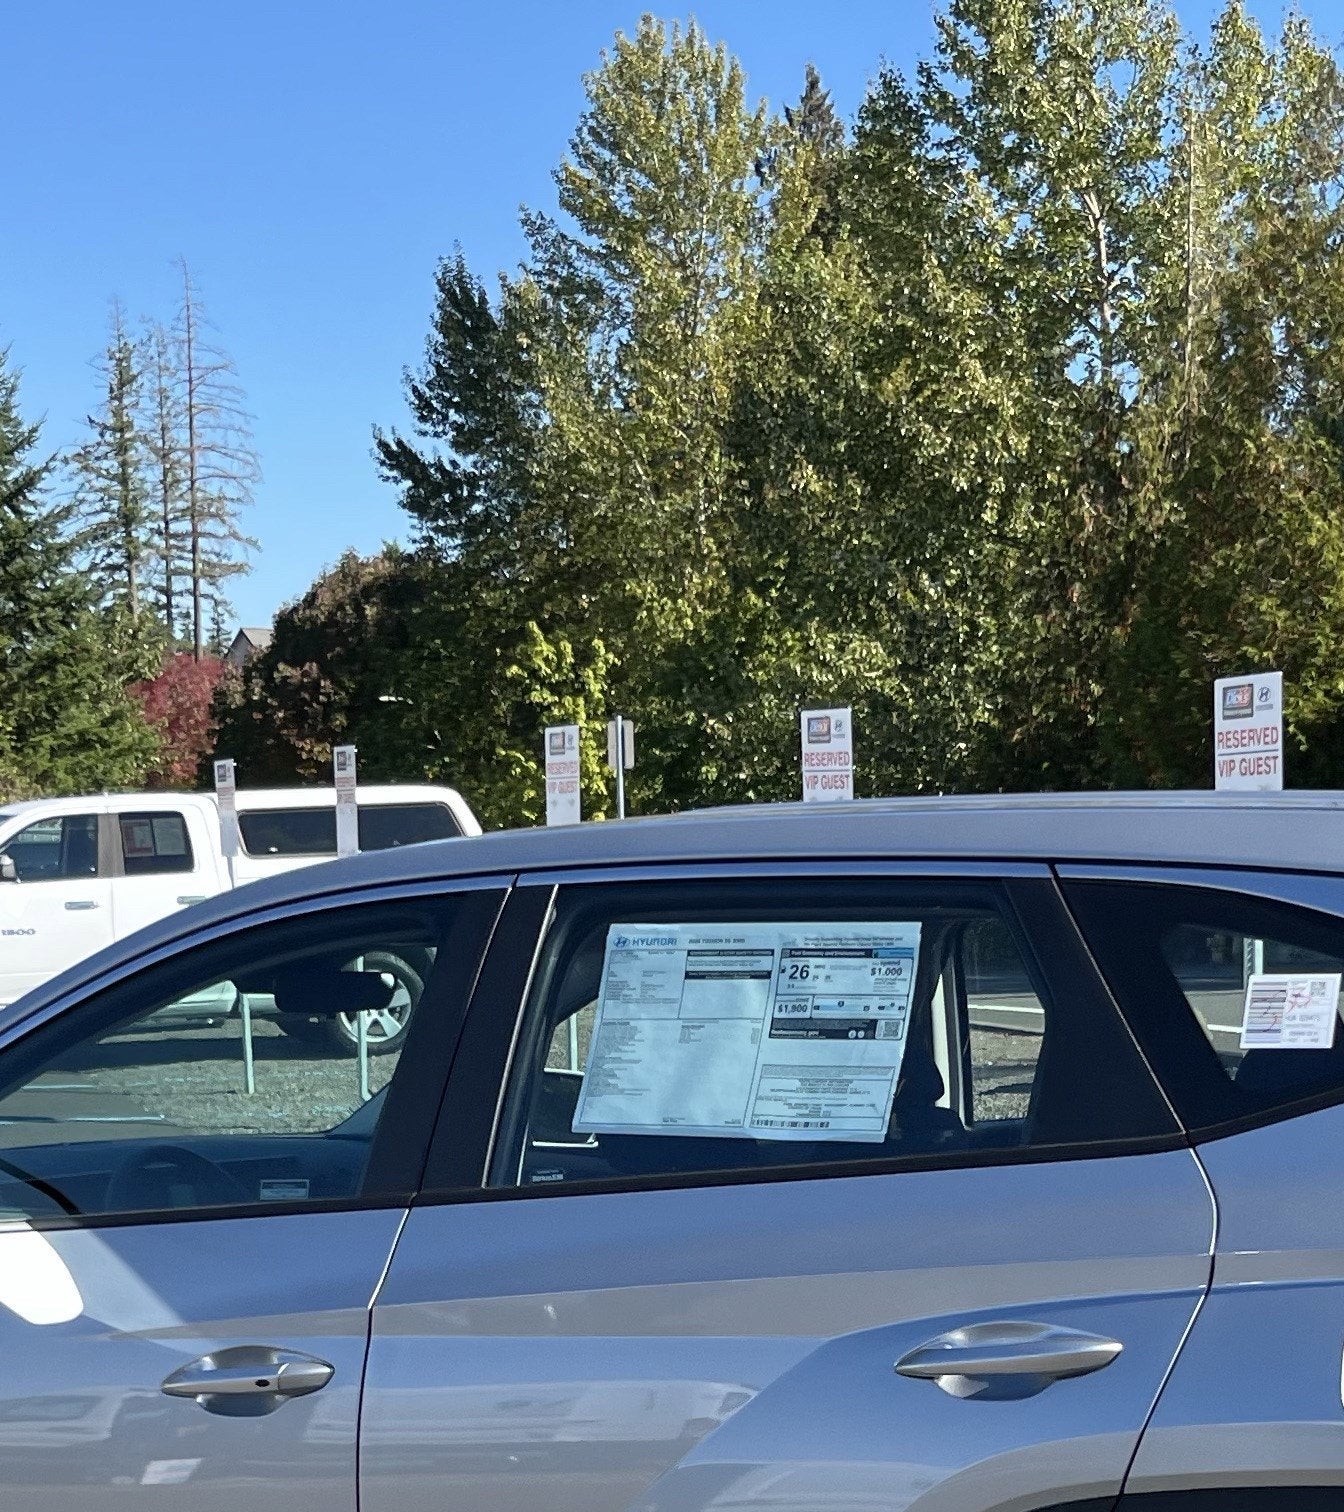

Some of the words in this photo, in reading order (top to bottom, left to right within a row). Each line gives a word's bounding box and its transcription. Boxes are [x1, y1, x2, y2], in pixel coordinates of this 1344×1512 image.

[1217, 726, 1279, 750] RESERVED
[804, 751, 851, 768] RESERVED
[1217, 758, 1236, 778] VIP
[1239, 755, 1279, 777] GUEST
[804, 775, 819, 790] VIP
[821, 773, 851, 790] GUEST
[632, 937, 678, 947] HYUNDAI
[788, 963, 811, 981] 26
